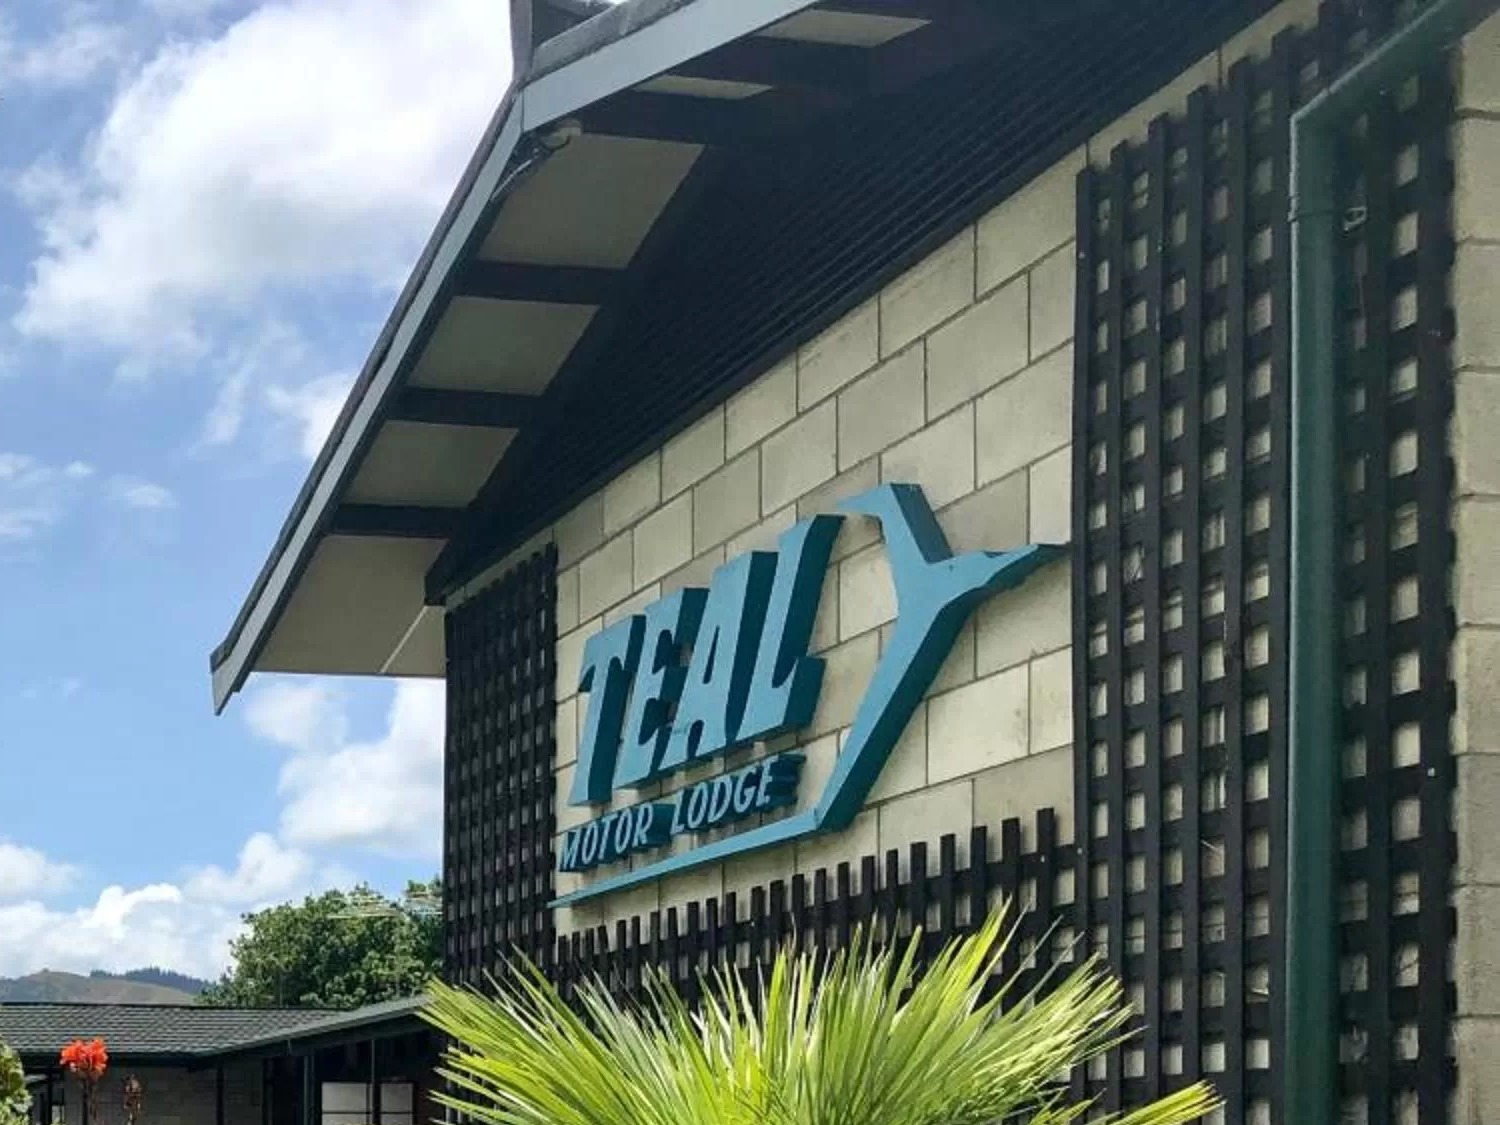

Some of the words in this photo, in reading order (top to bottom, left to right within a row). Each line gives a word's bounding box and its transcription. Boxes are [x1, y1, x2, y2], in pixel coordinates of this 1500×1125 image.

[569, 513, 822, 806] TEAL
[557, 803, 654, 870] MOTOR
[670, 755, 780, 835] LODGE
